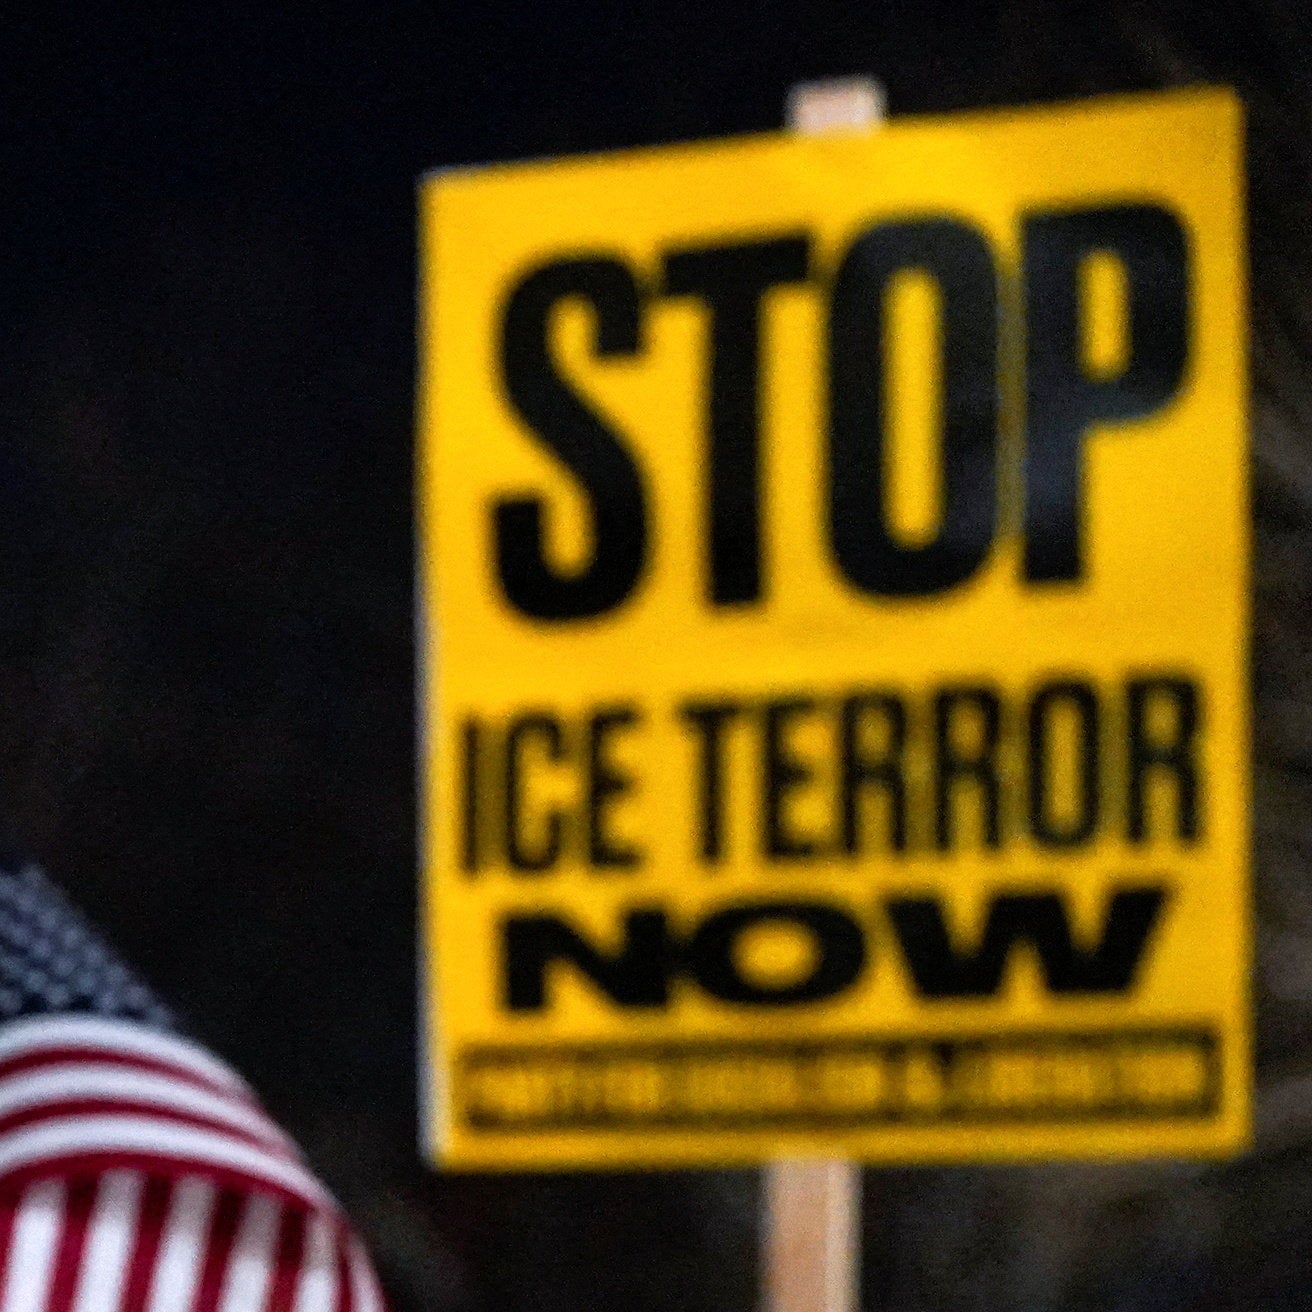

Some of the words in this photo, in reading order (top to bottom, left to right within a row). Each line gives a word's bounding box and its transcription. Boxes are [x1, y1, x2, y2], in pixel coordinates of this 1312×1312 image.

[486, 200, 1192, 632] STOP
[456, 706, 641, 879] ICE
[679, 668, 1208, 864] TERROR
[498, 873, 1173, 1015] NOW
